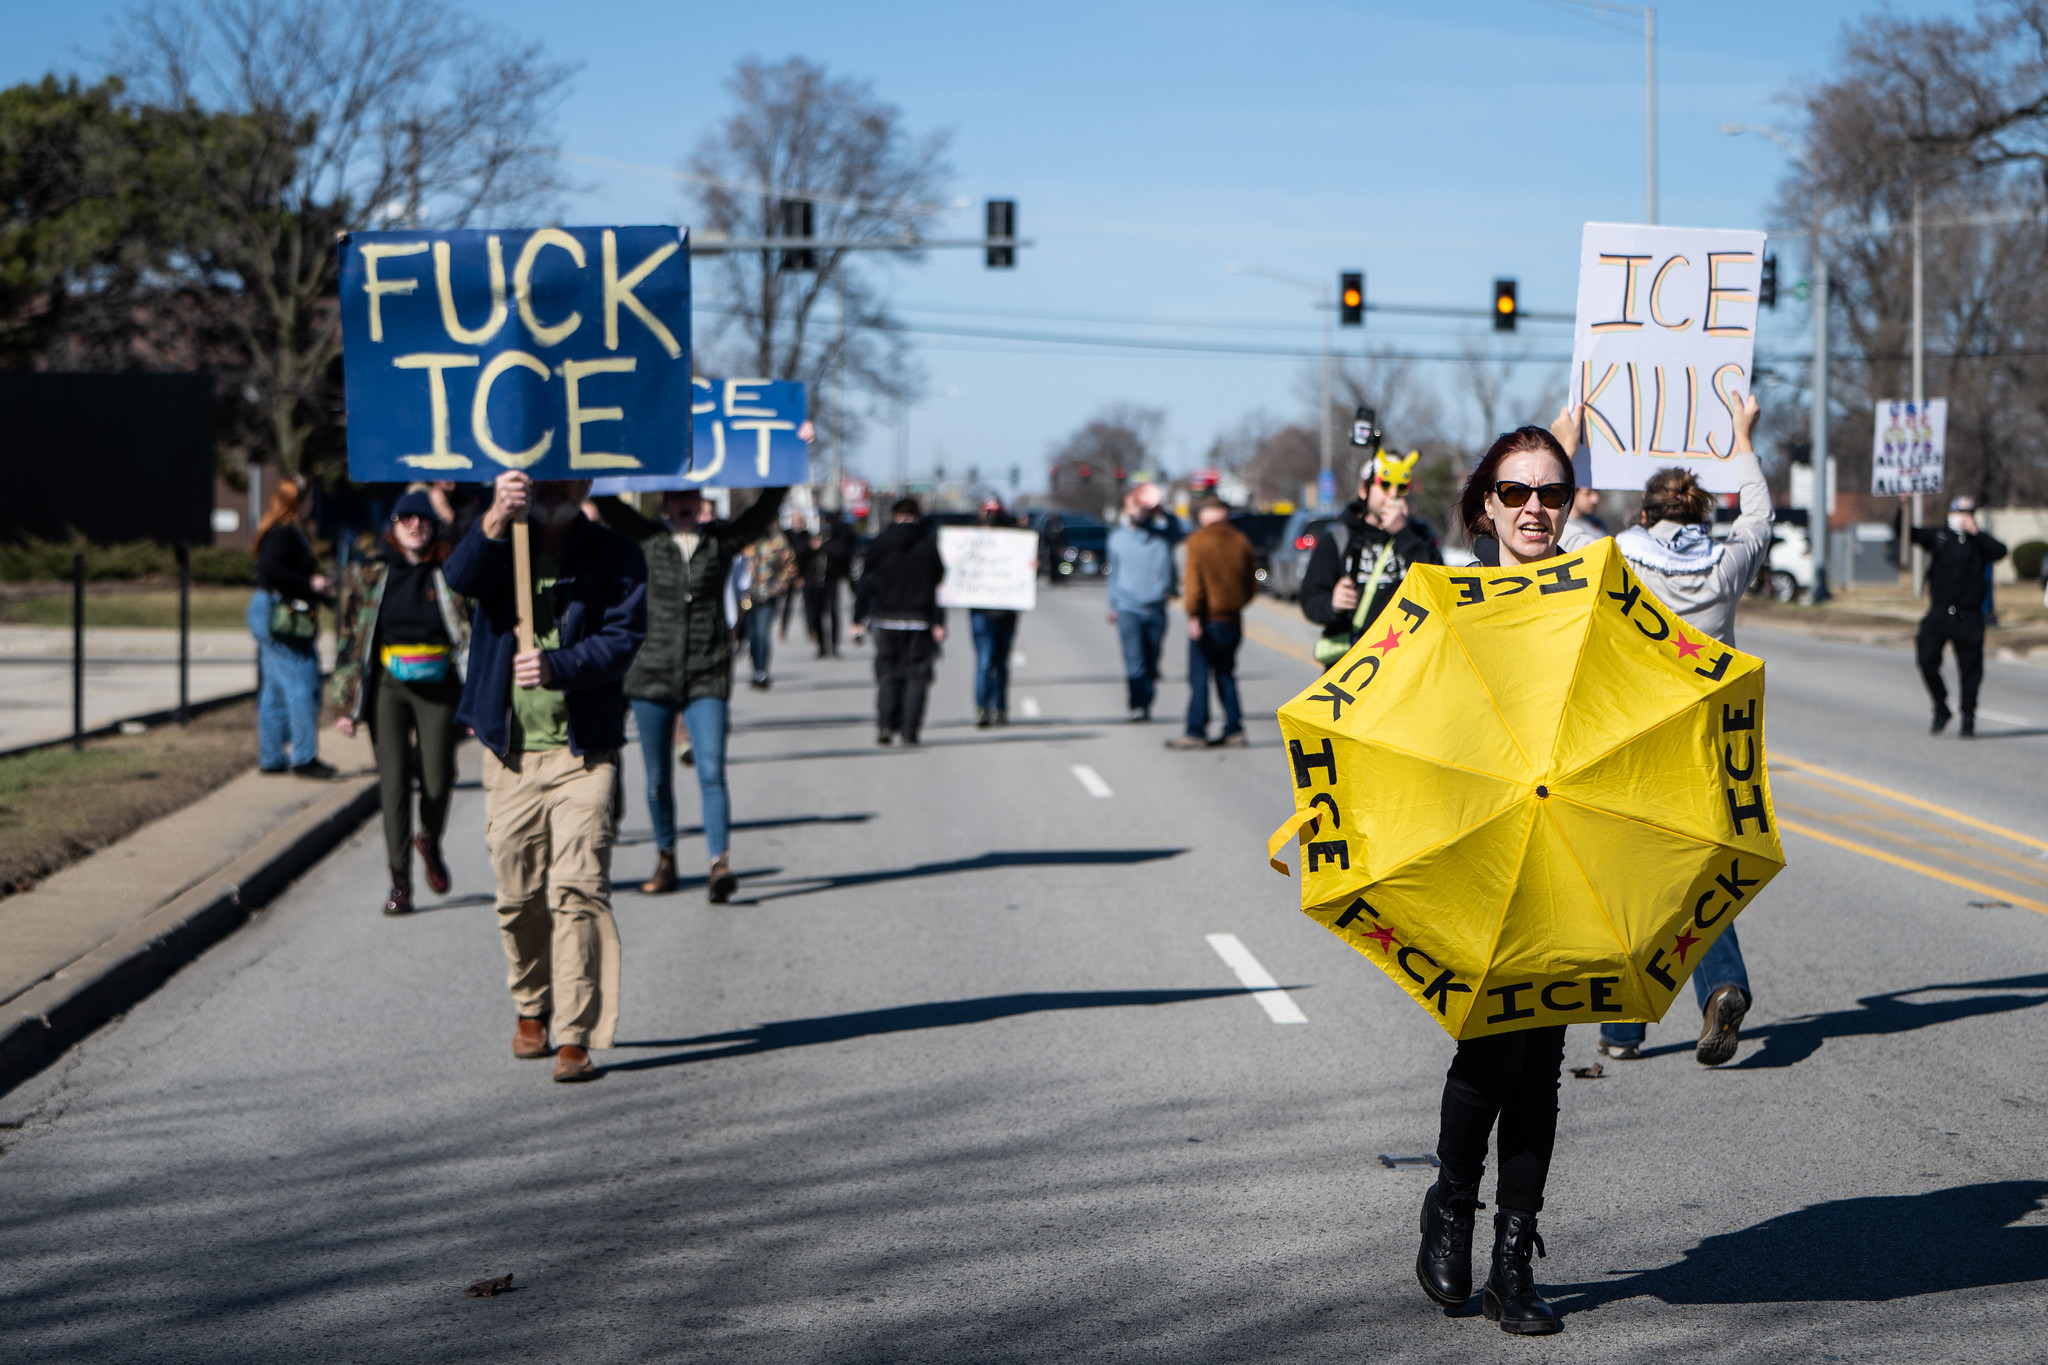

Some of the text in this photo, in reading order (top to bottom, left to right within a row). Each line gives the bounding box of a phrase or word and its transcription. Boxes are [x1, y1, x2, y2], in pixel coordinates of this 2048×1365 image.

[359, 228, 682, 359] FUCK
[1591, 253, 1756, 338] ICE
[392, 350, 643, 470] ICE
[1580, 360, 1745, 461] KILLS
[1450, 557, 1589, 607] ICE
[1289, 737, 1350, 873] ICE
[1723, 698, 1769, 836] ICE
[1486, 976, 1623, 1024] ICE
